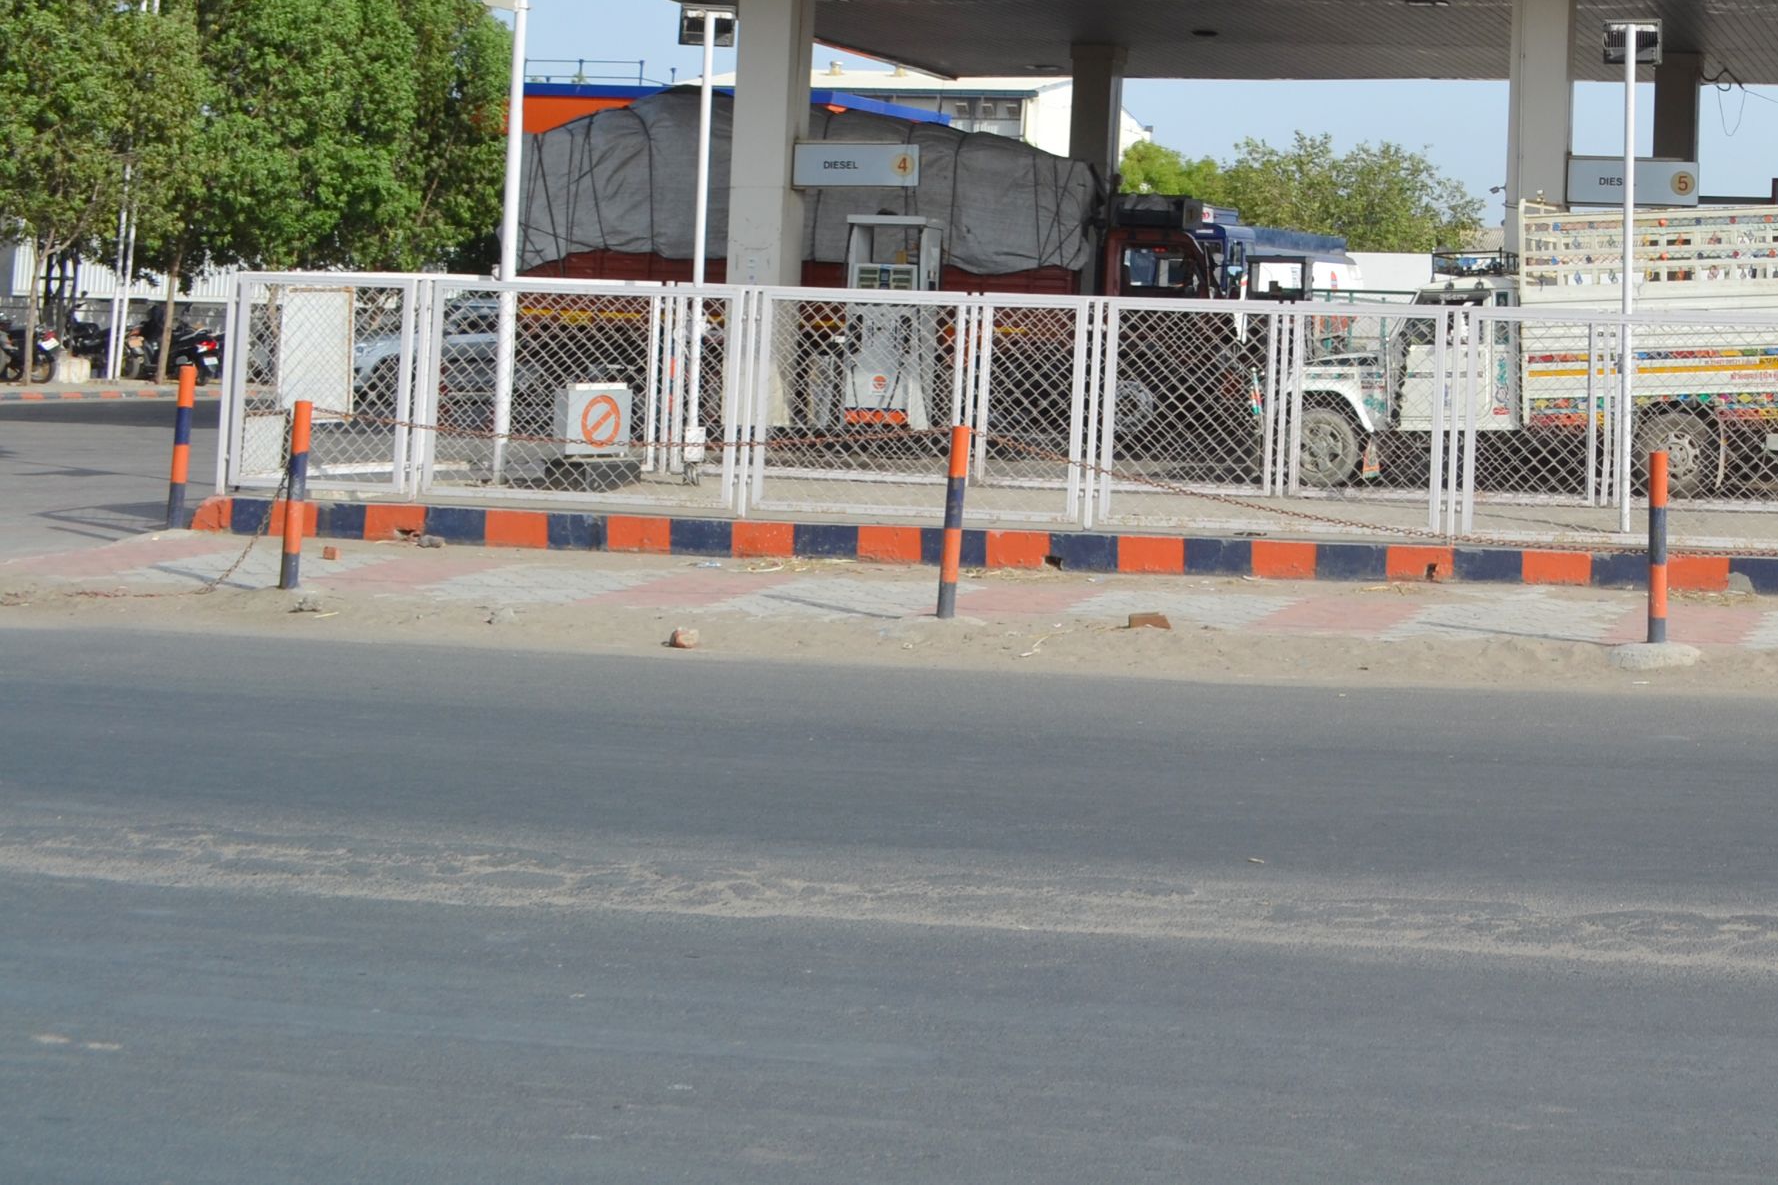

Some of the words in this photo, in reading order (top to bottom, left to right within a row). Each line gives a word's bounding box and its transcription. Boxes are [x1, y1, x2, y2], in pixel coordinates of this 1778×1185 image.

[823, 160, 858, 170] DIESEL
[897, 156, 908, 173] 4
[1598, 176, 1637, 187] DIES
[1677, 175, 1689, 192] 5
